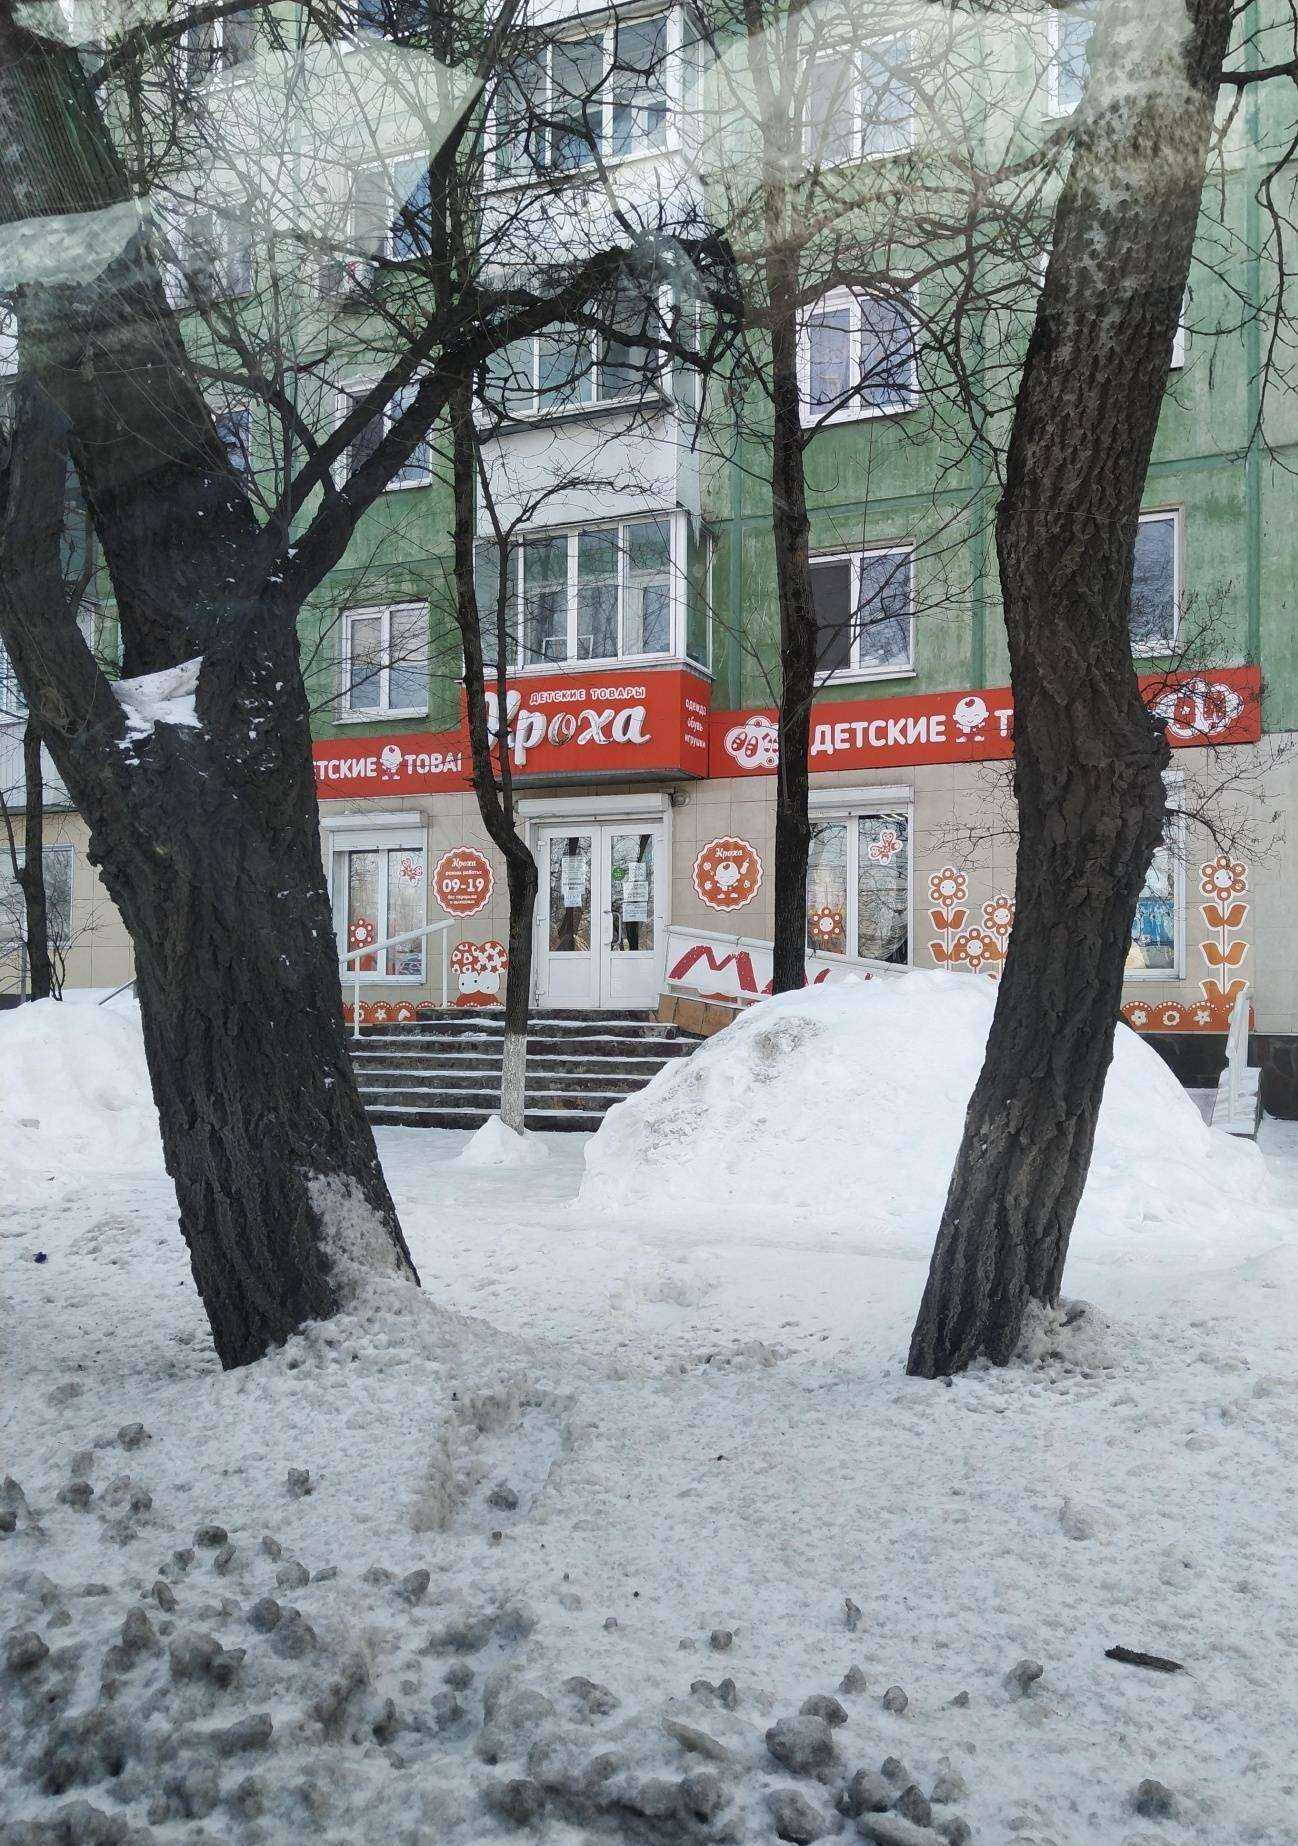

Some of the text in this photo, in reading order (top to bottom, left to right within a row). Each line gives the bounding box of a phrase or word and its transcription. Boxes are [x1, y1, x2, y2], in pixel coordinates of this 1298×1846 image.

[529, 686, 647, 706] ДЕТСКИЕ ТОВАРЫ
[685, 698, 707, 716] одежда
[484, 688, 652, 767] Кроха
[687, 716, 704, 732] обувь
[810, 714, 947, 756] ДЕТСКИЕ
[312, 751, 462, 781] ТСКИЕ ТОВА
[714, 847, 743, 859] Кроха
[442, 878, 485, 892] 09-19
